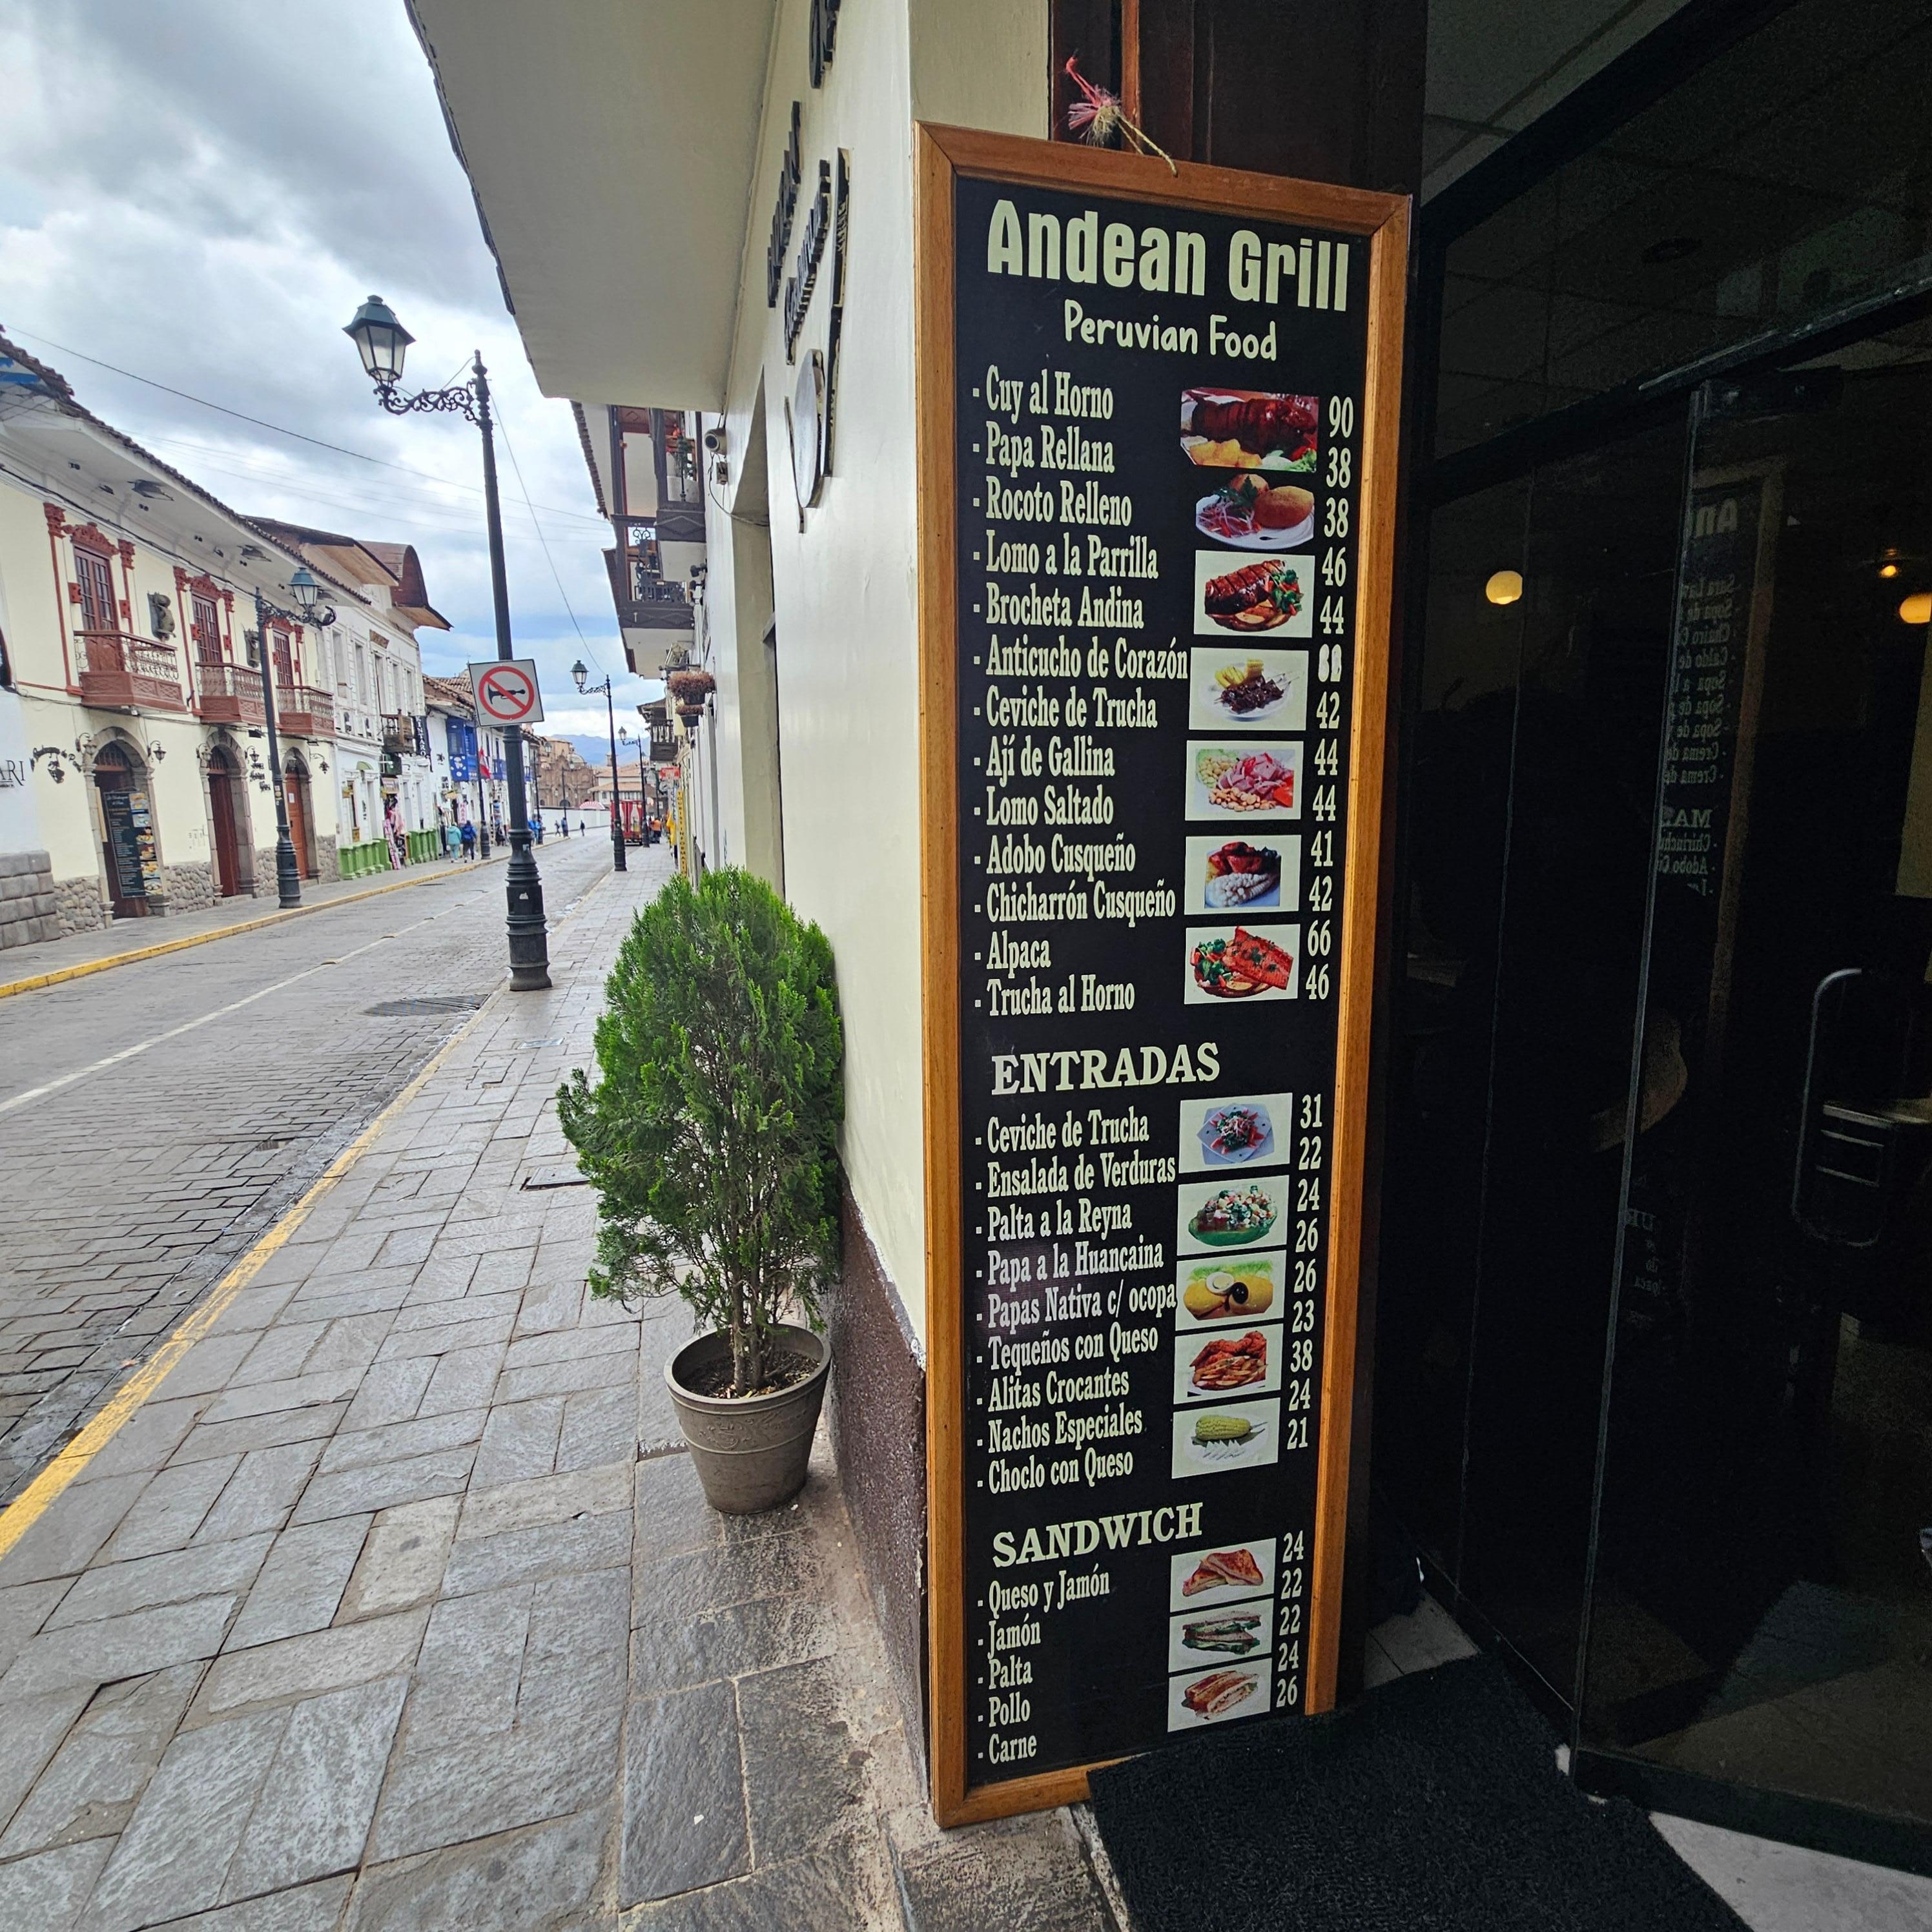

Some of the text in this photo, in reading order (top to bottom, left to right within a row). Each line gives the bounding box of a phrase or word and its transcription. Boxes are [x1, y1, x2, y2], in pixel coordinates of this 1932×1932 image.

[988, 200, 1348, 311] Andean Grill
[1065, 299, 1276, 361] Peruvian Food
[987, 365, 1113, 424] Cuy al Horno
[1330, 396, 1353, 438] 90
[986, 421, 1115, 477] Papa Rellana
[1326, 447, 1350, 488] 38
[986, 476, 1131, 526] Rocoto Relleno
[1324, 497, 1348, 537] 38
[987, 529, 1158, 579] Lomo a la Parrilla
[1322, 547, 1346, 586] 46
[987, 582, 1144, 628] Brocheta Andina
[1321, 596, 1344, 634] 44
[986, 634, 1187, 679] Anticucho de Corazón
[987, 685, 1157, 728] Ceviche de Trucha
[1317, 692, 1339, 728] 42
[986, 734, 1115, 787] Ají de Gallina
[1315, 739, 1337, 775] 44
[987, 785, 1113, 825] Lomo Saltado
[1313, 785, 1335, 821] 44
[987, 832, 1135, 881] Adobo Cusqueño
[1311, 830, 1333, 867] 41
[987, 879, 1175, 927] Chicharrón Cusqueño
[1310, 876, 1331, 911] 42
[987, 930, 1051, 978] Alpaca
[1308, 920, 1330, 956] 66
[987, 974, 1135, 1016] Trucha al Horno
[1306, 963, 1329, 1000] 46
[992, 1043, 1220, 1095] ENTRADAS
[988, 1106, 1149, 1153] Ceviche de Trucha
[1300, 1094, 1322, 1128] 31
[988, 1149, 1175, 1197] Ensalada de Verduras
[1299, 1136, 1321, 1170] 22
[1297, 1178, 1319, 1211] 24
[988, 1198, 1132, 1241] Palta a la Reyna
[1295, 1218, 1318, 1252] 26
[988, 1235, 1164, 1292] Papa a la Huancaina
[1294, 1259, 1316, 1293] 26
[989, 1279, 1176, 1334] Papas Nativa c/ ocopa
[1292, 1300, 1313, 1333] 23
[988, 1322, 1158, 1376] Tequeños con Queso
[1291, 1339, 1312, 1372] 38
[988, 1367, 1129, 1412] Alitas Crocantes
[1289, 1378, 1310, 1411] 24
[989, 1403, 1142, 1453] Nachos Especiales
[1288, 1417, 1308, 1449] 21
[989, 1448, 1133, 1494] Choclo con Queso
[992, 1503, 1203, 1567] SANDWICH
[1283, 1530, 1304, 1563] 24
[989, 1563, 1109, 1619] Queso y Jamón
[1281, 1568, 1302, 1599] 22
[988, 1613, 1041, 1659] Jamón
[1279, 1605, 1300, 1636] 22
[989, 1655, 1033, 1689] Palta
[1278, 1640, 1299, 1671] 24
[989, 1692, 1030, 1727] Pollo
[1277, 1676, 1297, 1707] 26
[989, 1734, 1036, 1763] Carne
